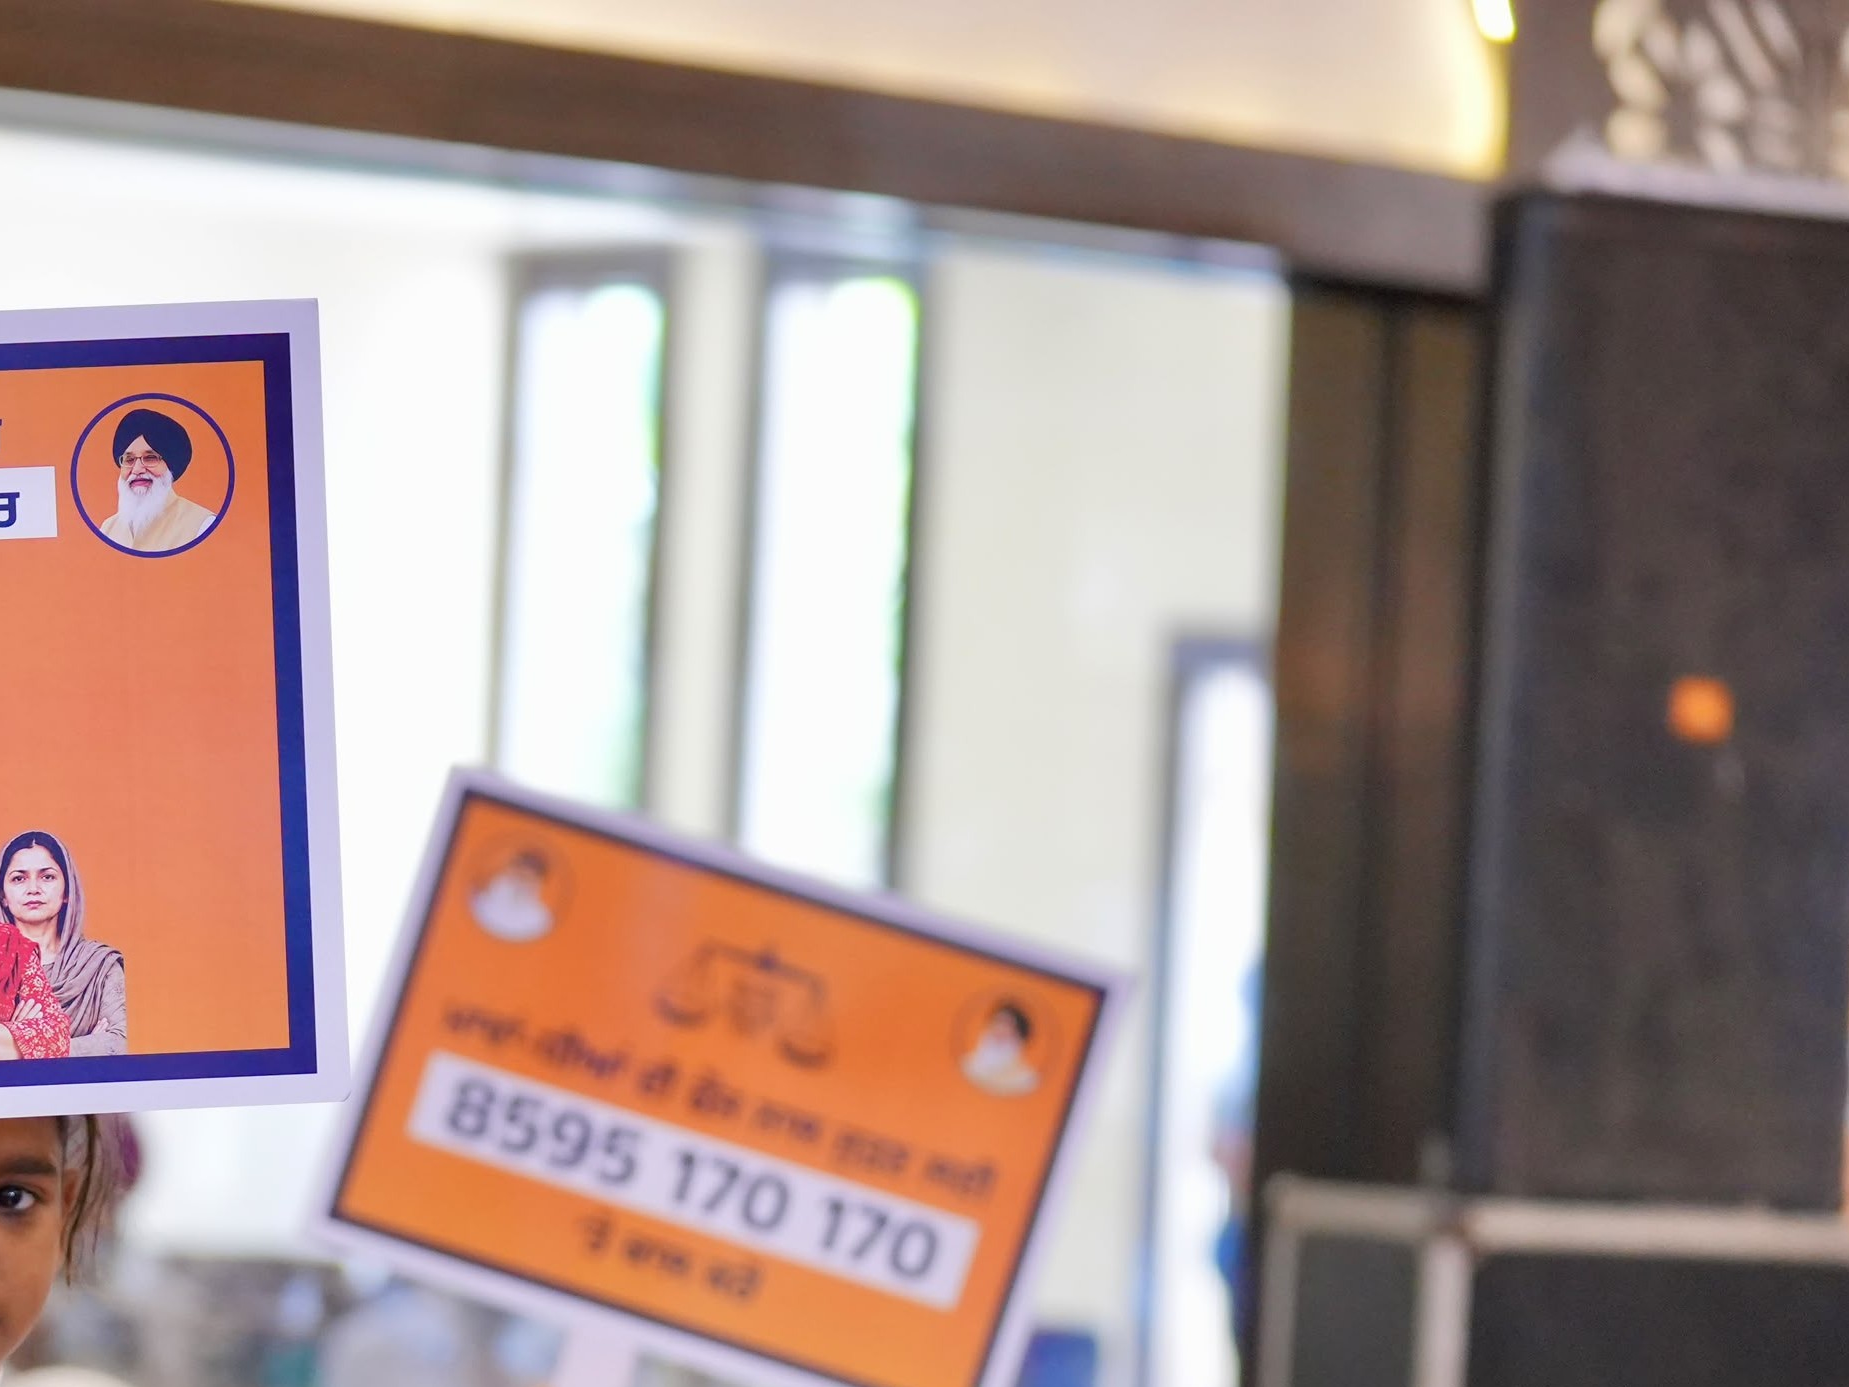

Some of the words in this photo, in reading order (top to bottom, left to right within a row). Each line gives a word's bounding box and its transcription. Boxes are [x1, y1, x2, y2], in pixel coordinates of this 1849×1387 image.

[444, 1077, 643, 1186] 8595
[670, 1148, 791, 1234] 170
[821, 1200, 939, 1282] 170
